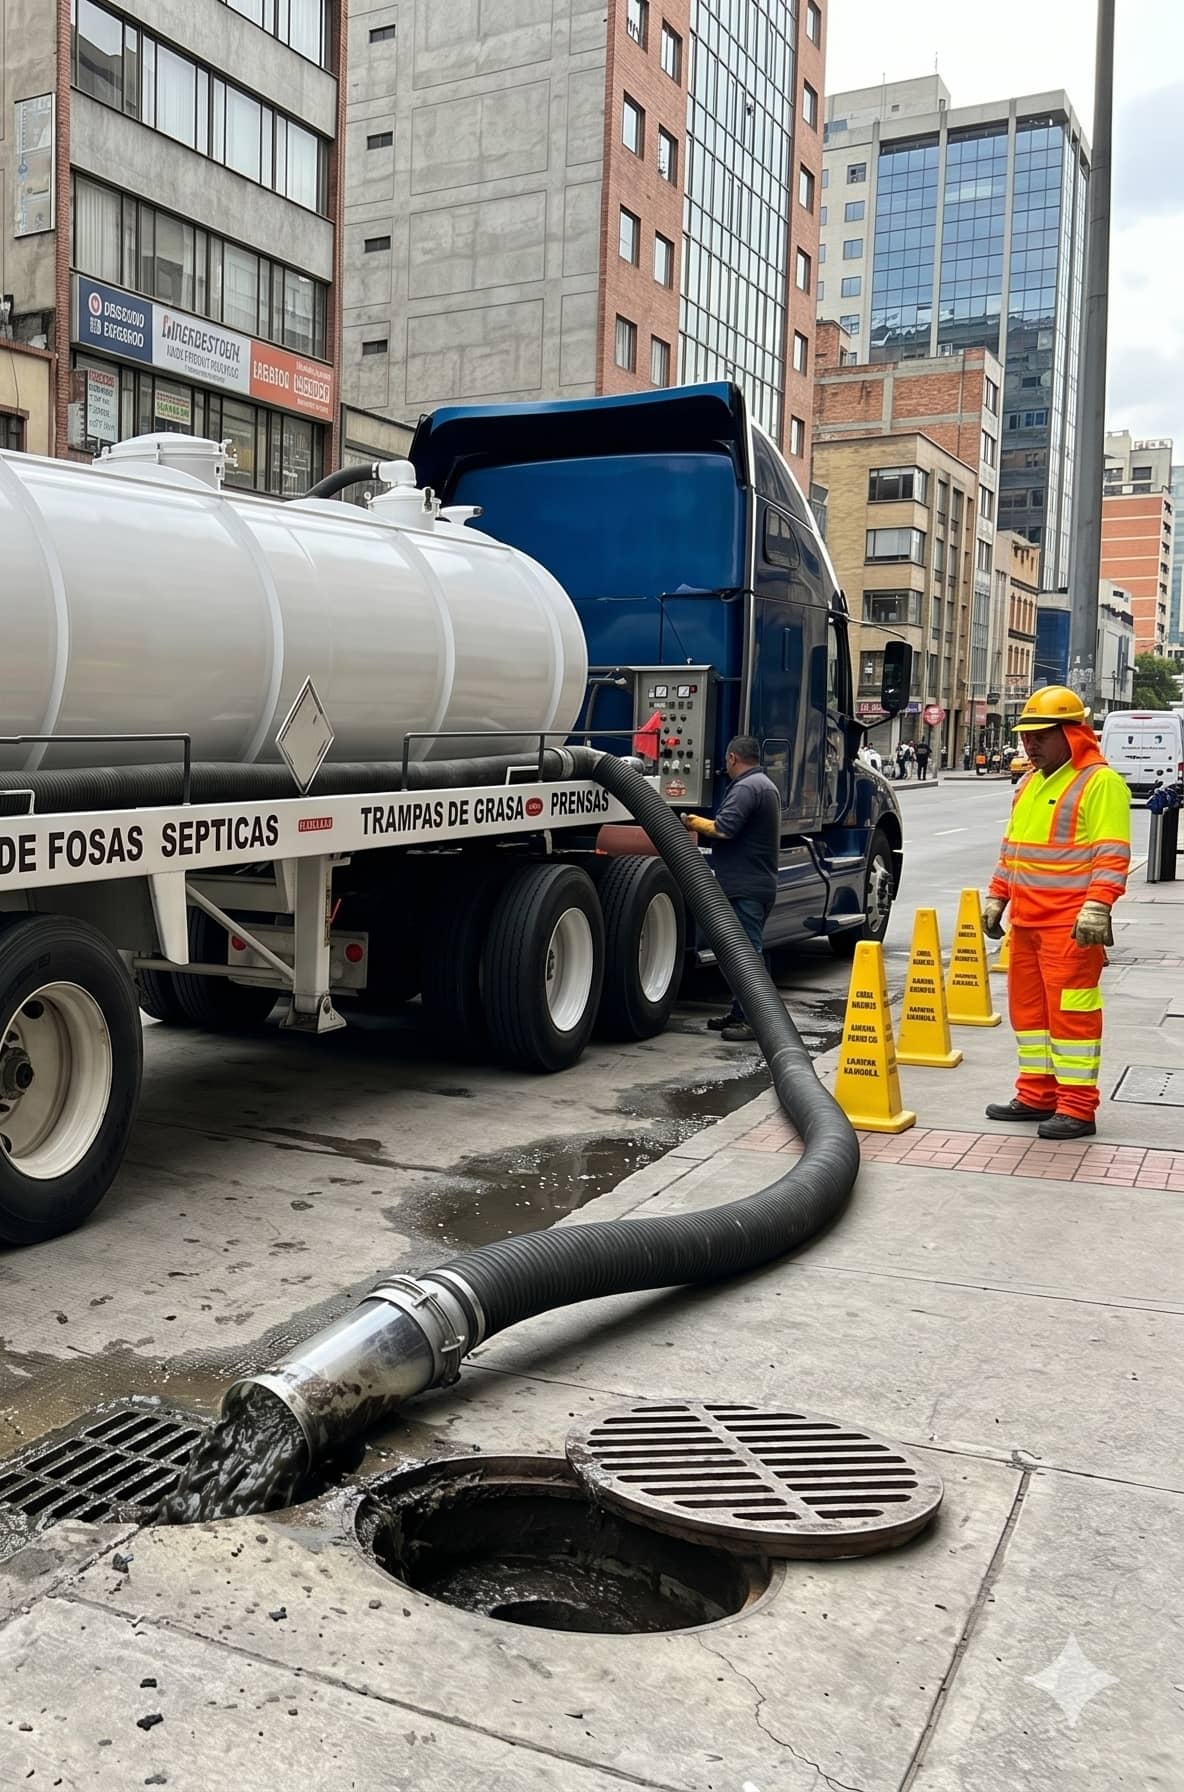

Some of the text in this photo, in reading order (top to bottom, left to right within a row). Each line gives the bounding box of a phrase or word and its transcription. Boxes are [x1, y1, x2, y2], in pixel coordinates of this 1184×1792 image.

[361, 800, 442, 835] TRAMPAS
[448, 799, 469, 826] DE
[474, 795, 524, 825] GRASA
[550, 789, 609, 817] PRENSAS
[49, 825, 144, 869] FOSAS
[161, 814, 280, 858] SEPTICAS
